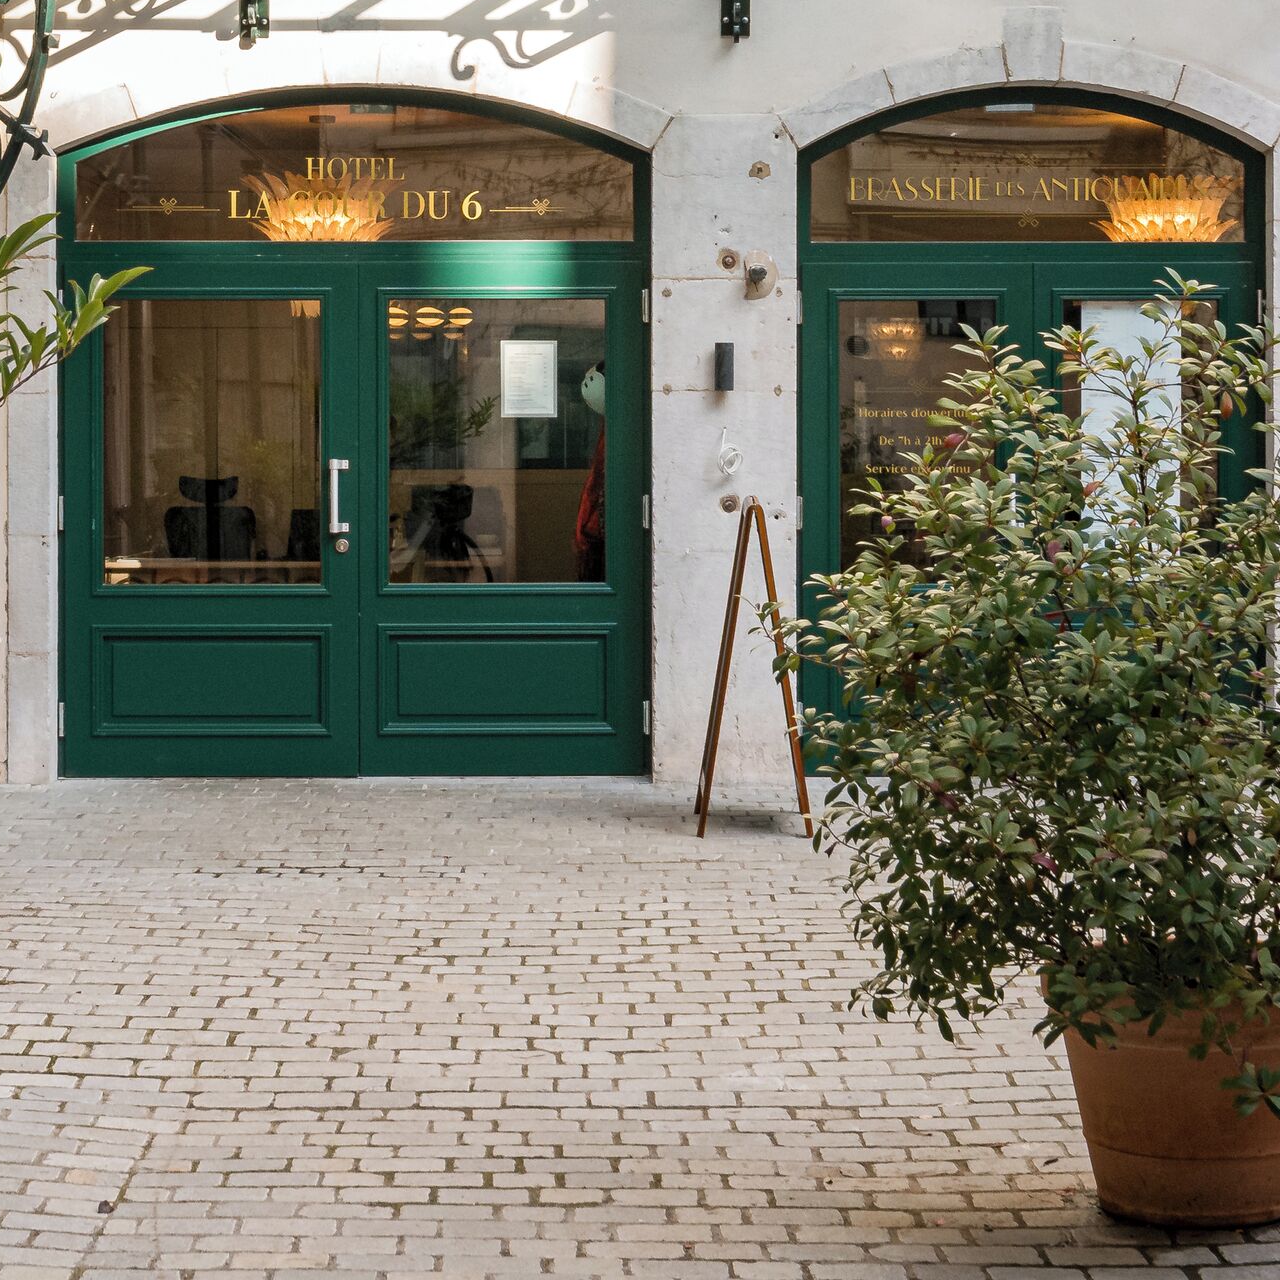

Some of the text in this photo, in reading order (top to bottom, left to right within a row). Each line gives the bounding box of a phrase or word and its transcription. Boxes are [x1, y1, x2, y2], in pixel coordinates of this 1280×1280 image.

[305, 157, 405, 181] HOTEL
[850, 176, 989, 201] BRASSERIE
[996, 181, 1025, 196] DES
[228, 190, 482, 220] LA COUR DU 6
[858, 407, 908, 418] Horaires
[879, 435, 895, 446] De
[914, 435, 922, 446] à
[865, 463, 908, 474] Service
